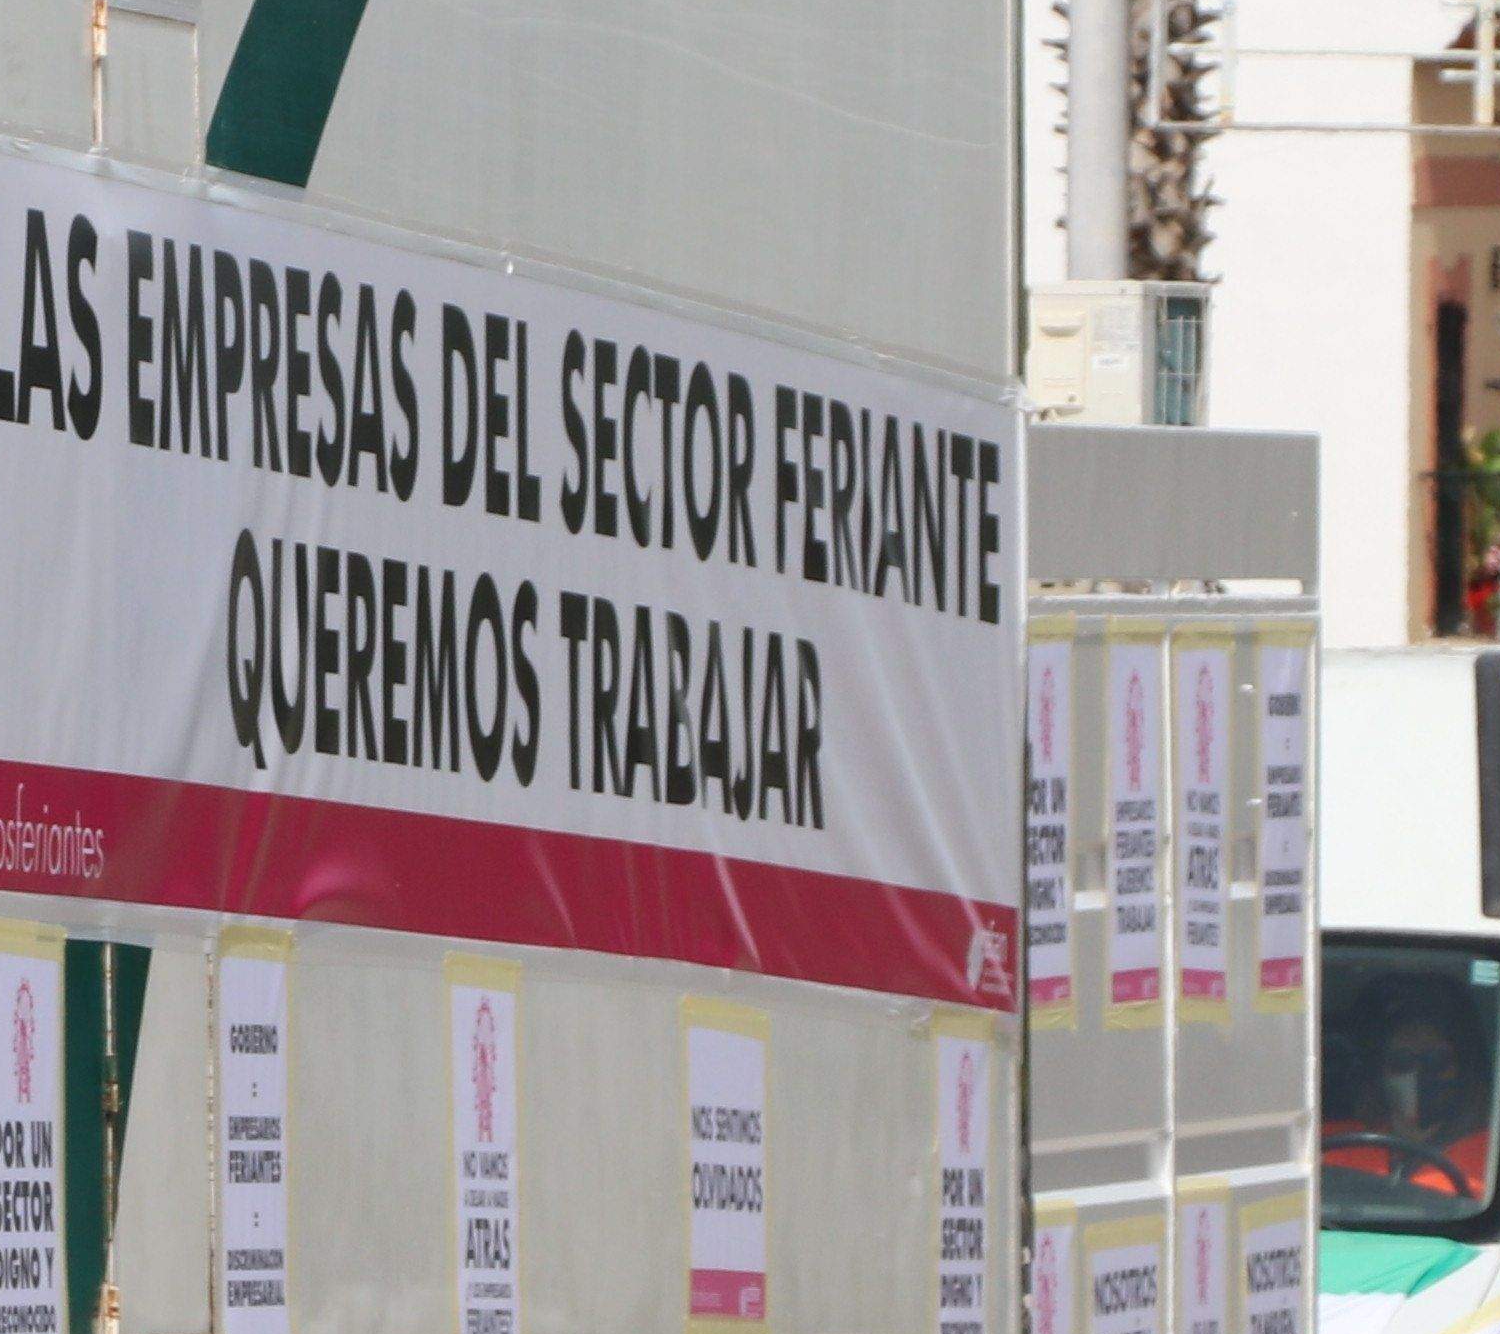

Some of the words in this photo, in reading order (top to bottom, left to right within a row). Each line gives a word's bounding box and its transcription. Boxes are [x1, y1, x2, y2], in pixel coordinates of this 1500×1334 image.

[126, 230, 419, 503] EMPRESAS
[441, 303, 542, 524] DEL
[559, 327, 757, 567] SECTOR
[773, 385, 1000, 625] FERIANTE
[227, 525, 541, 789] QUEREMOS
[559, 591, 826, 832] TRABAJAR
[31, 1120, 53, 1168] UN
[45, 1246, 55, 1290] Y
[465, 1218, 511, 1271] ATRAS
